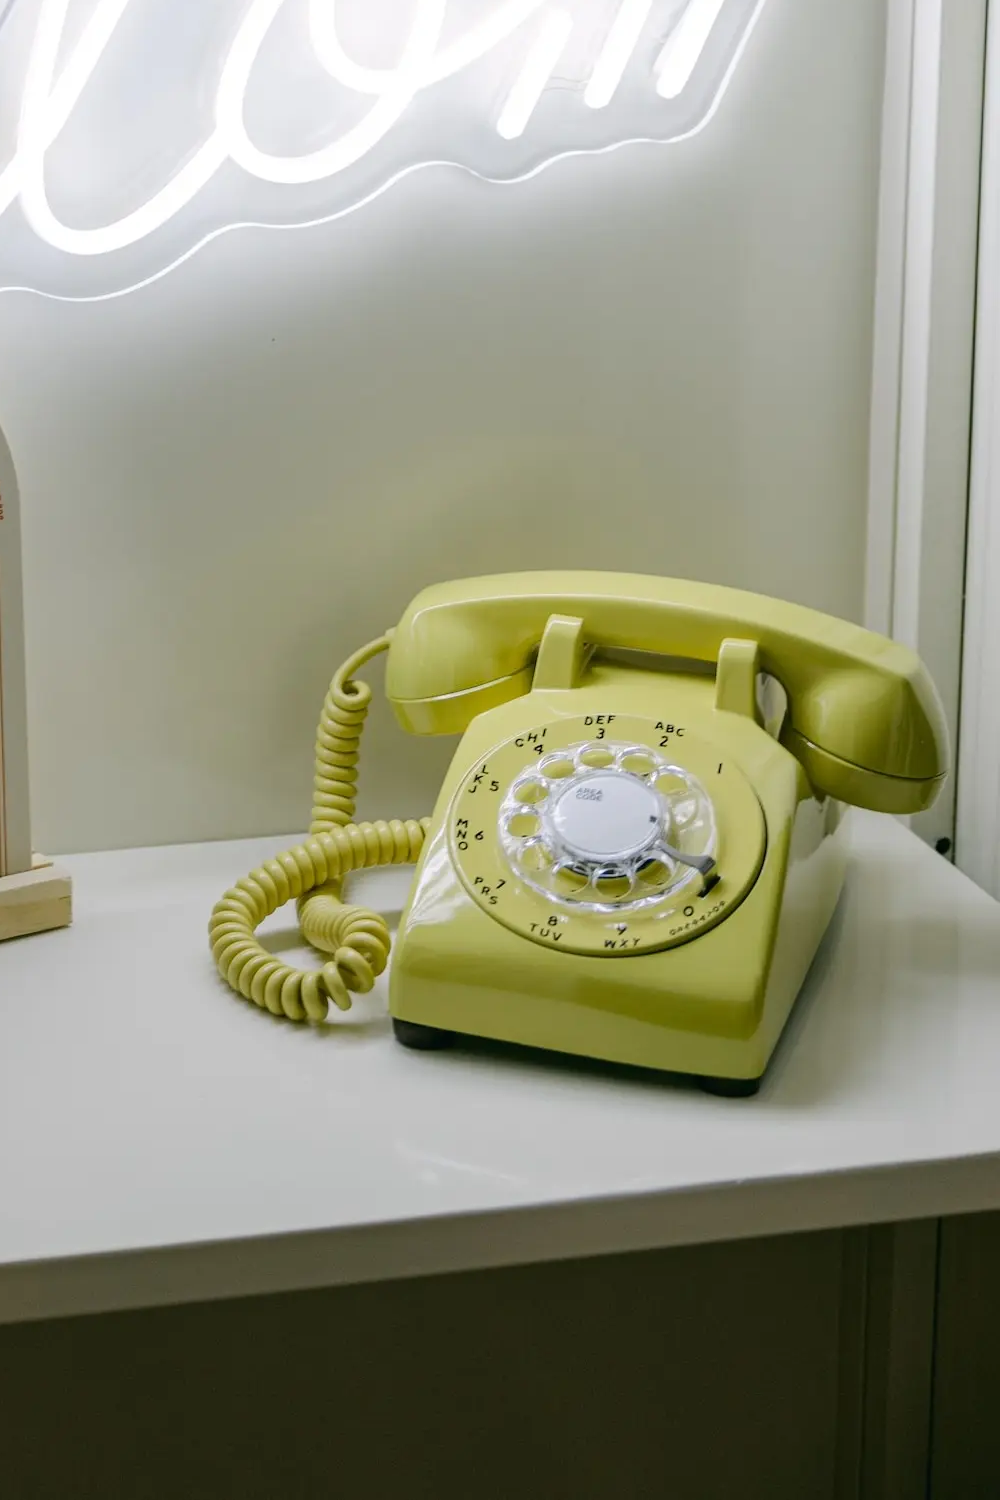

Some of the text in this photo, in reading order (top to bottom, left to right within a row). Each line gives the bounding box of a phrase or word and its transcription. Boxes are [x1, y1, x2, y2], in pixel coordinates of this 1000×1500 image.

[584, 715, 616, 726] DEF
[596, 728, 605, 740] 3
[655, 721, 687, 738] ABC
[659, 735, 670, 748] 2
[534, 744, 544, 755] 4
[489, 780, 500, 792] 5
[474, 830, 484, 841] 6
[496, 879, 507, 890] 7
[547, 915, 558, 926] 8
[529, 923, 563, 942] TUV
[616, 925, 627, 935] 9
[603, 938, 641, 949] WXY
